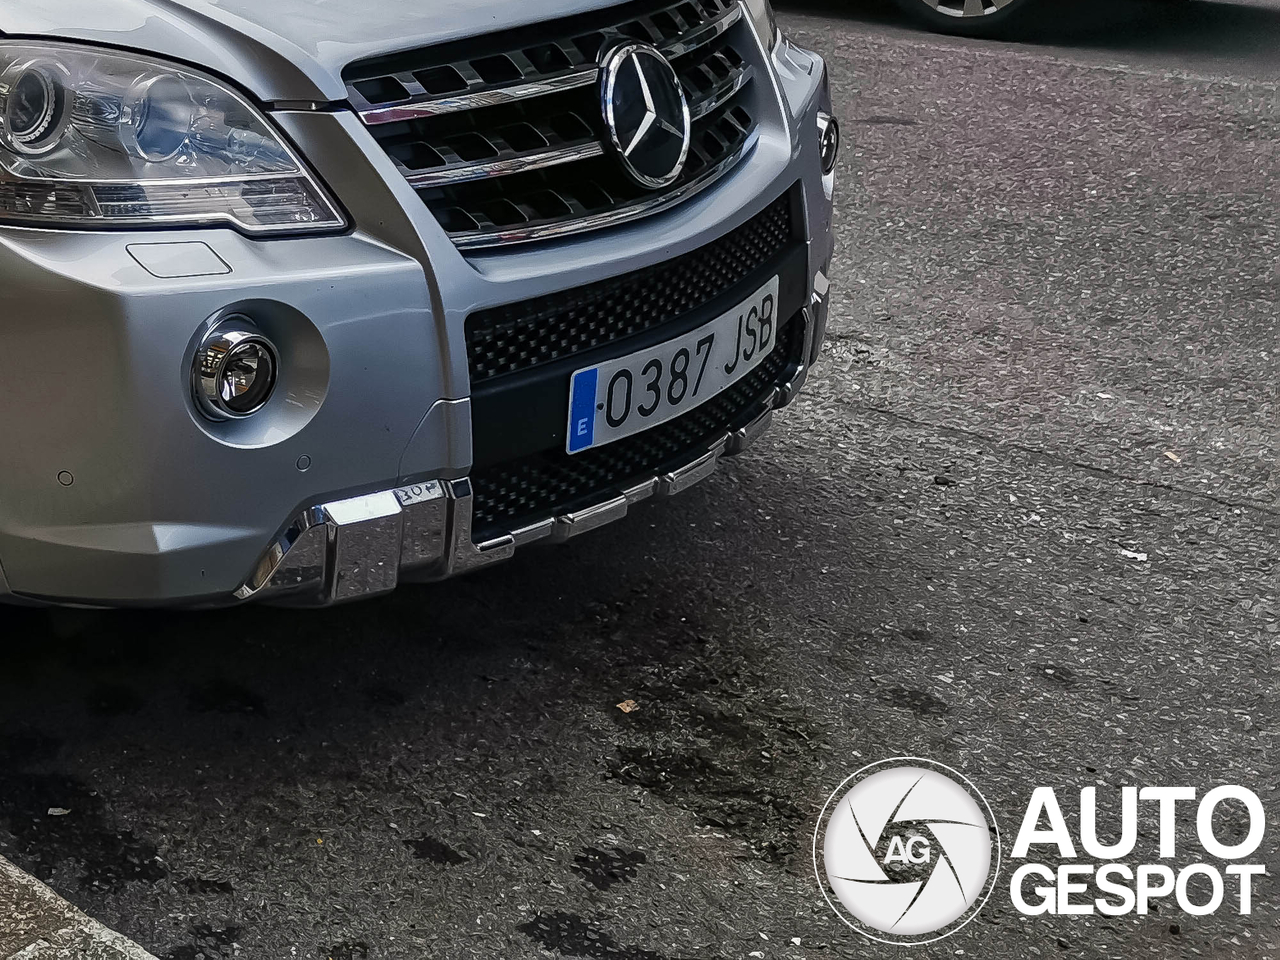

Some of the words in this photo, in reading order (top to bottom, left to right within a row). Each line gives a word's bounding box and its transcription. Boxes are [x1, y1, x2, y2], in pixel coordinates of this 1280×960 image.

[577, 417, 588, 436] E
[605, 332, 715, 428] 0387
[724, 293, 774, 375] JSB
